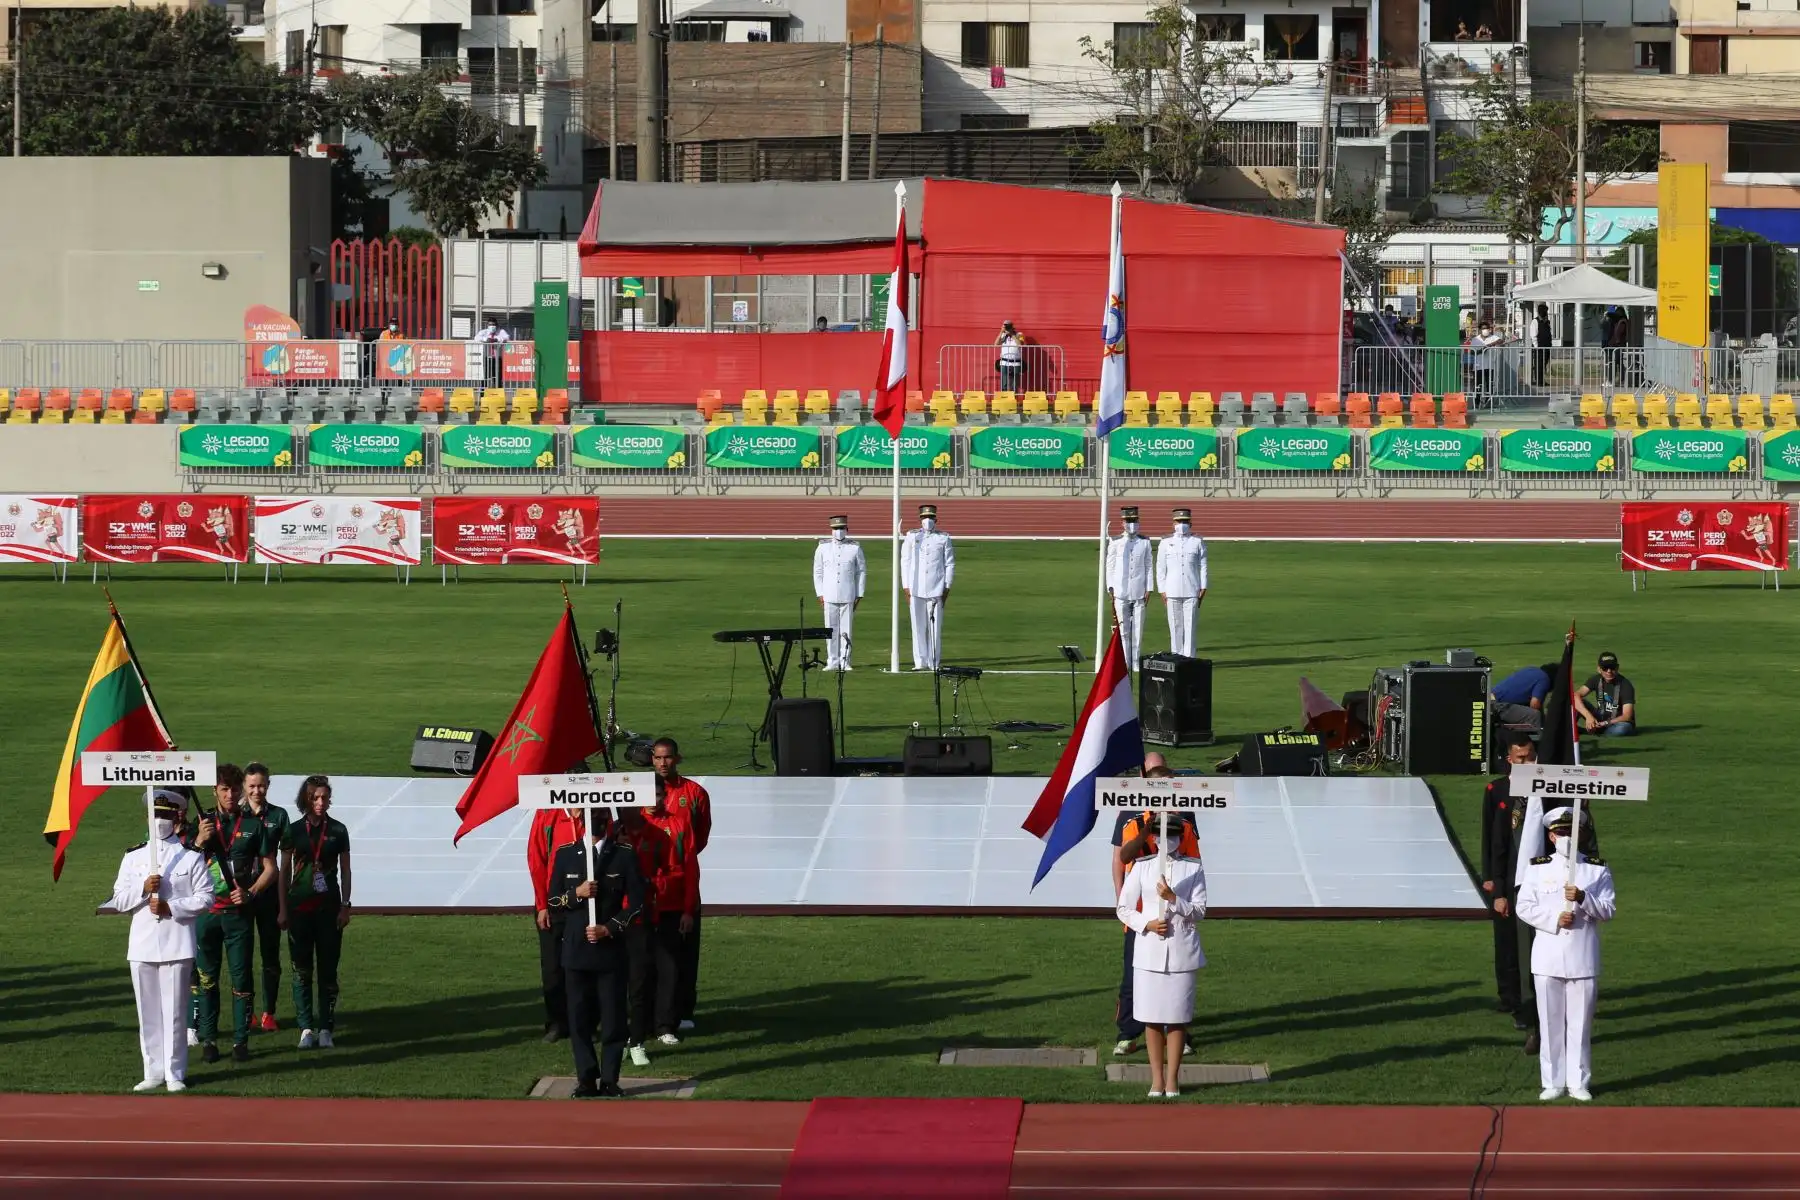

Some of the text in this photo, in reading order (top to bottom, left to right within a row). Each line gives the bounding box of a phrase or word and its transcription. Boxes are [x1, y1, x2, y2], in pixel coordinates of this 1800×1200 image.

[131, 523, 156, 531] WMC
[164, 523, 186, 531] PERÚ
[303, 524, 327, 532] WMC
[481, 525, 506, 533] WMC
[514, 525, 536, 533] PERÚ
[1670, 530, 1695, 539] WMC
[1704, 531, 1726, 539] PERÚ
[422, 728, 473, 742] M.Chong
[1470, 702, 1485, 760] M.Chong
[1264, 734, 1319, 745] M.Chong
[102, 767, 195, 781] Lithuania
[1532, 779, 1627, 795] Palestine
[550, 789, 635, 804] Morocco
[1102, 792, 1227, 808] Netherlands
